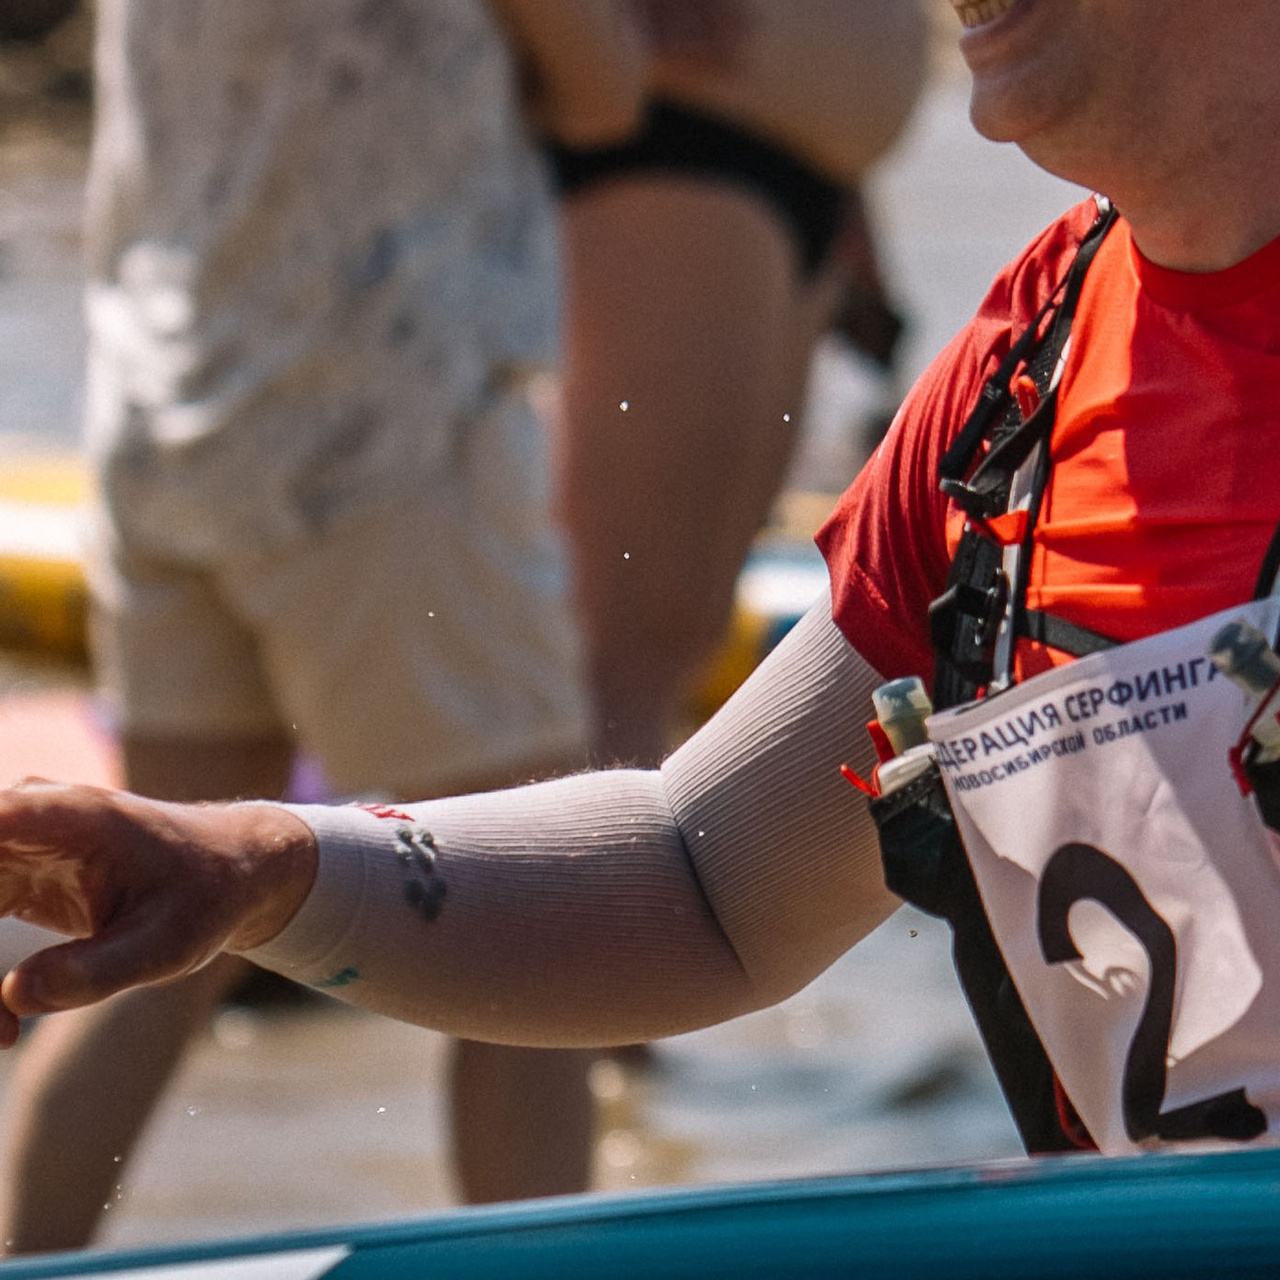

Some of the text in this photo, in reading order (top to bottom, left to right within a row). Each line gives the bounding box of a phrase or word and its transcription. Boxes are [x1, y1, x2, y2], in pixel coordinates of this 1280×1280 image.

[936, 703, 1062, 772] ДЕРАЦИЯ
[1093, 702, 1188, 745] ОБЛАСТИ
[1037, 842, 1269, 1143] 2
